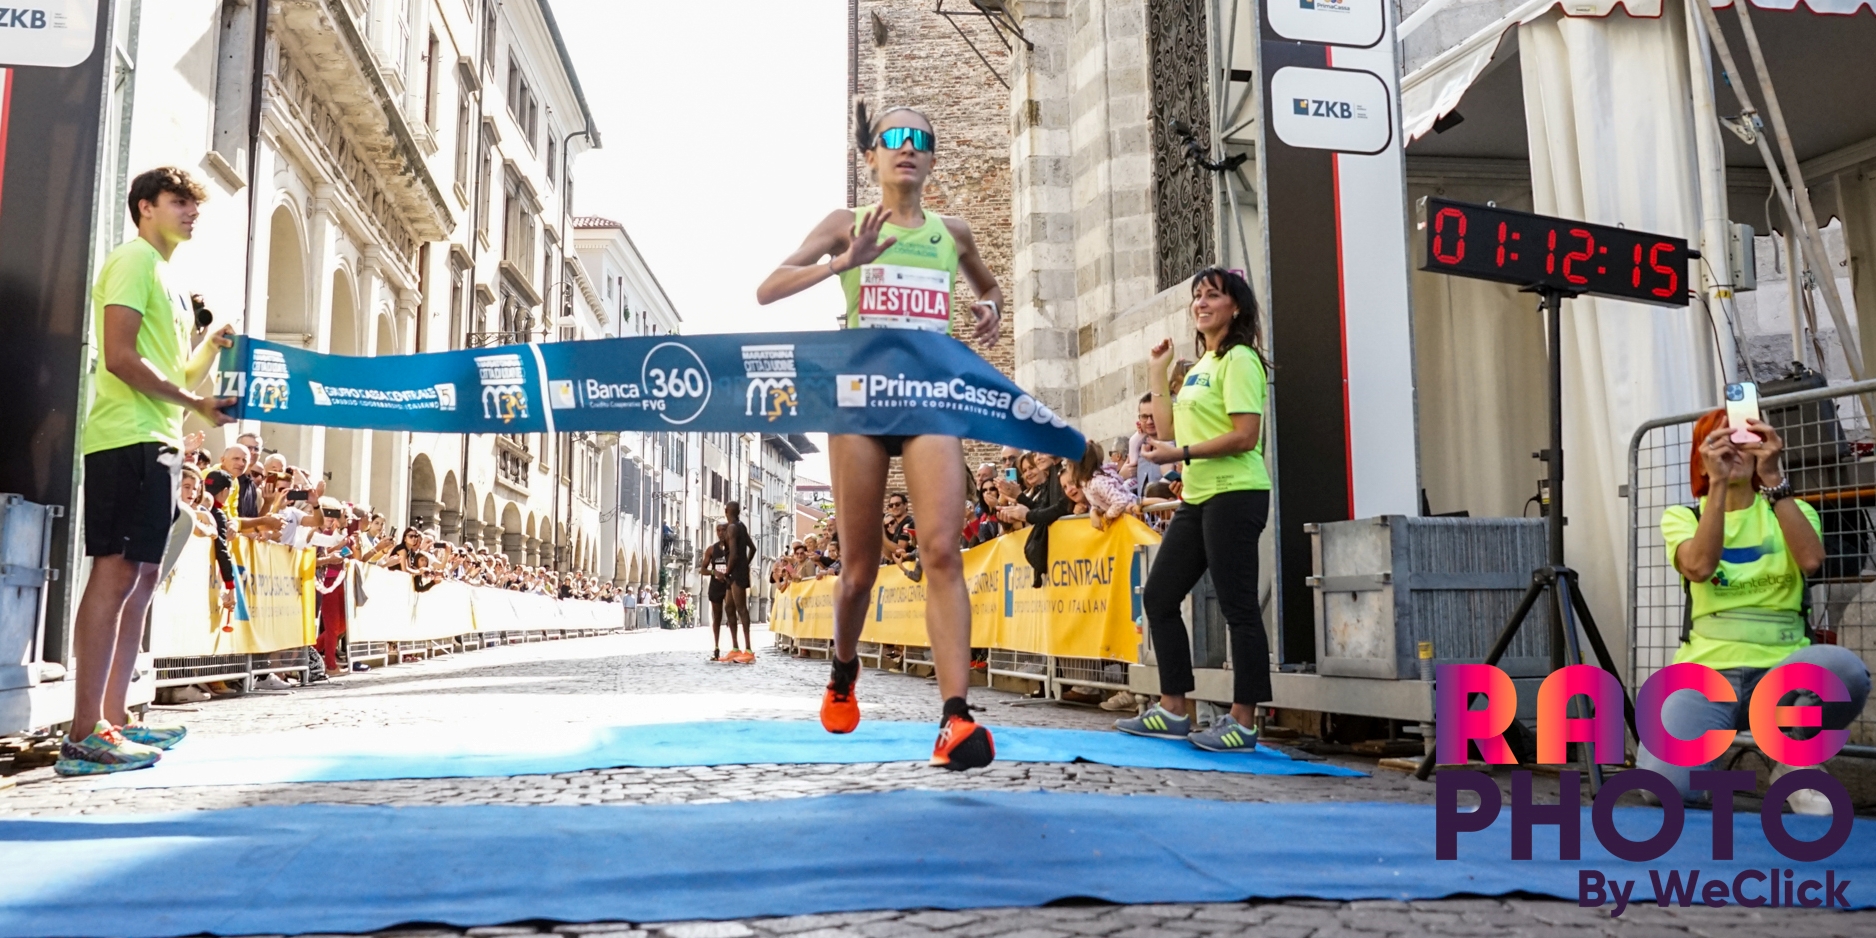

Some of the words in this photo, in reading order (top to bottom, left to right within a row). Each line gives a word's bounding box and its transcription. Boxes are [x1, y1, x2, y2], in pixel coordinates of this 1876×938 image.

[1317, 2, 1350, 11] PrimaCassa
[0, 7, 47, 29] ZKB
[1312, 99, 1352, 119] ZKB
[1432, 207, 1678, 298] 01:12:15
[862, 287, 946, 316] NESTOLA
[586, 379, 640, 399] Banca
[649, 367, 704, 398] 360
[870, 373, 1012, 410] PrimaCassa
[642, 399, 666, 411] FVG
[870, 400, 917, 408] CREDITO
[921, 399, 988, 416] COOPERATIVO
[991, 410, 1006, 420] FVG
[1729, 573, 1792, 590] Sintetica
[1067, 598, 1108, 614] ITALIAN
